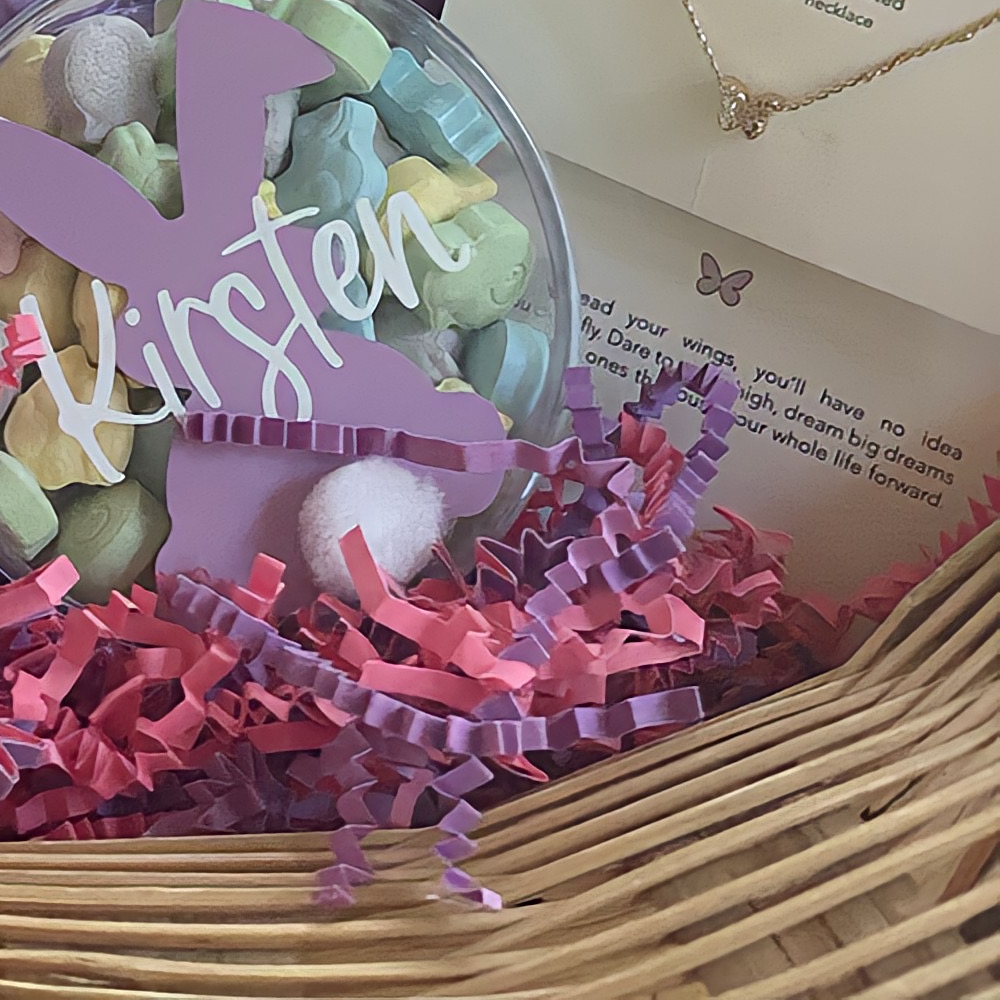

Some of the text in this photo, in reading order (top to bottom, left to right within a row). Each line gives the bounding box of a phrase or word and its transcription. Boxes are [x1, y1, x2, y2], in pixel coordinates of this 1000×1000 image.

[18, 190, 472, 485] Kirsten
[585, 351, 630, 378] ones
[771, 426, 829, 462] whole
[832, 448, 863, 476] life
[607, 327, 651, 359] Dare
[784, 404, 845, 441] dream
[848, 427, 881, 460] big
[884, 445, 955, 486] dreams
[625, 313, 670, 338] your
[683, 335, 738, 372] wings,
[819, 387, 866, 421] have
[879, 417, 906, 438] no
[921, 431, 963, 462] idea
